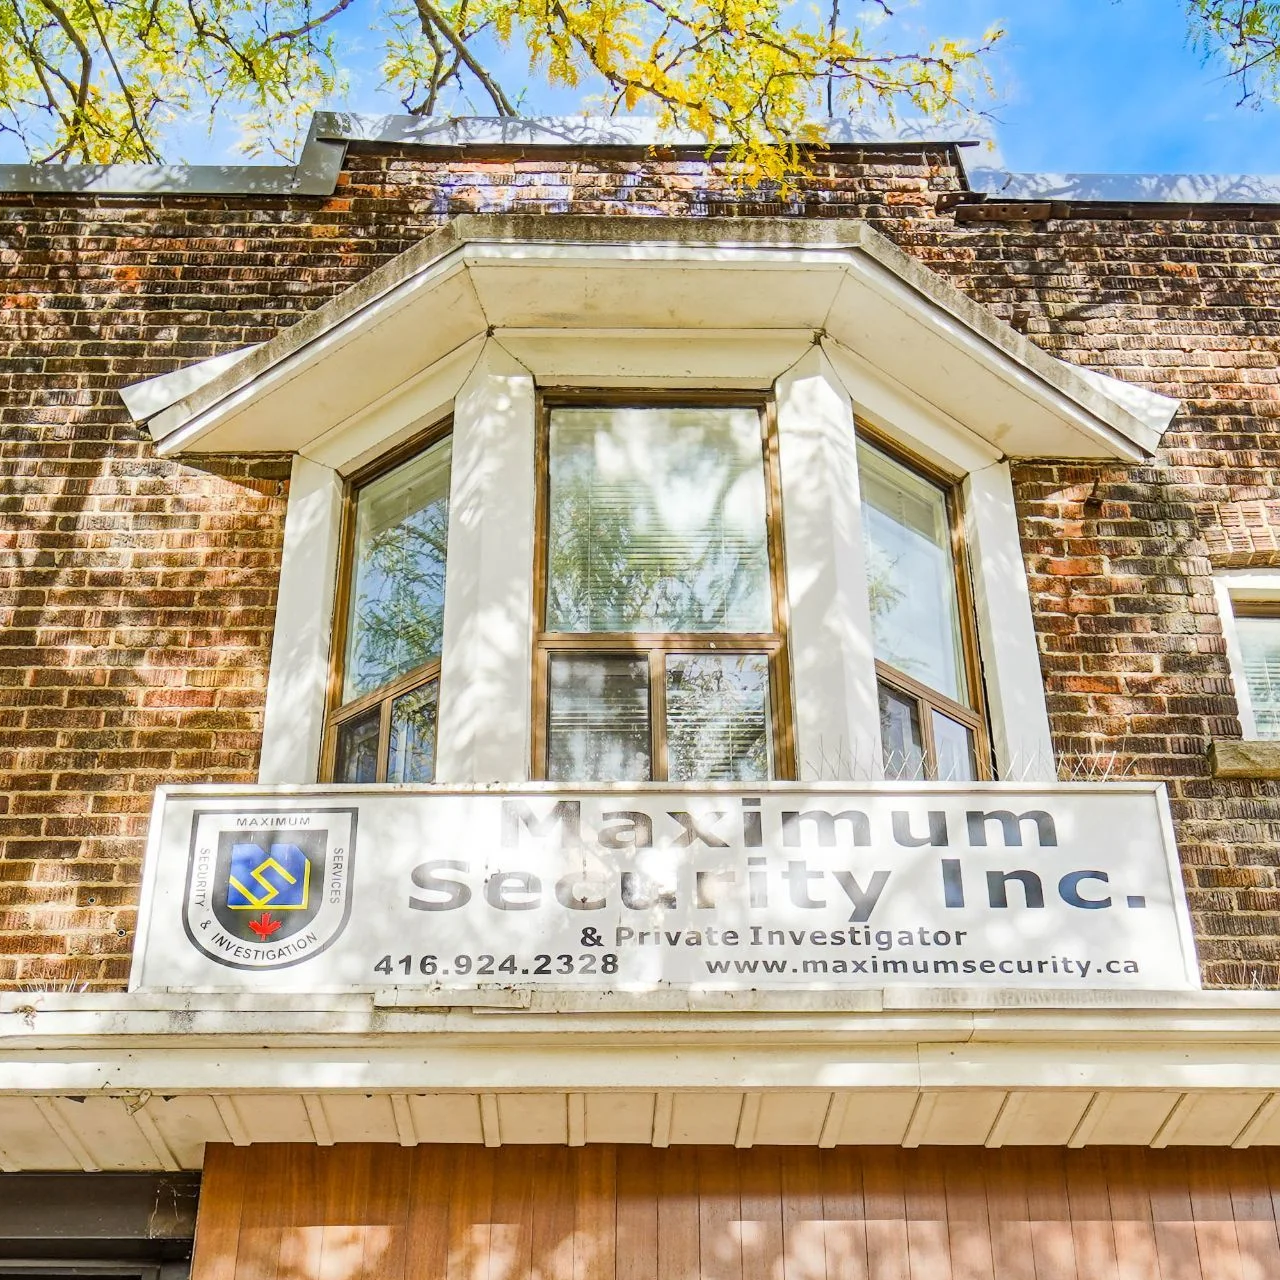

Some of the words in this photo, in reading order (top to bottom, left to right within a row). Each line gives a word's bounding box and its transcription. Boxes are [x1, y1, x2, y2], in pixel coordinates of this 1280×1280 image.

[236, 817, 311, 827] MAXIMUM
[500, 797, 1059, 848] Maximum
[194, 847, 211, 907] SECURITY
[329, 847, 344, 905] SERVICES
[407, 857, 892, 923] Security
[941, 858, 1146, 910] Inc.
[199, 919, 212, 930] &
[580, 926, 605, 948] &
[614, 925, 740, 947] Private
[749, 925, 968, 951] Investigator
[210, 931, 319, 961] INVESTIGATION
[373, 953, 620, 976] 416.924.2328
[705, 955, 1140, 979] www.maximumsecurity.ca
